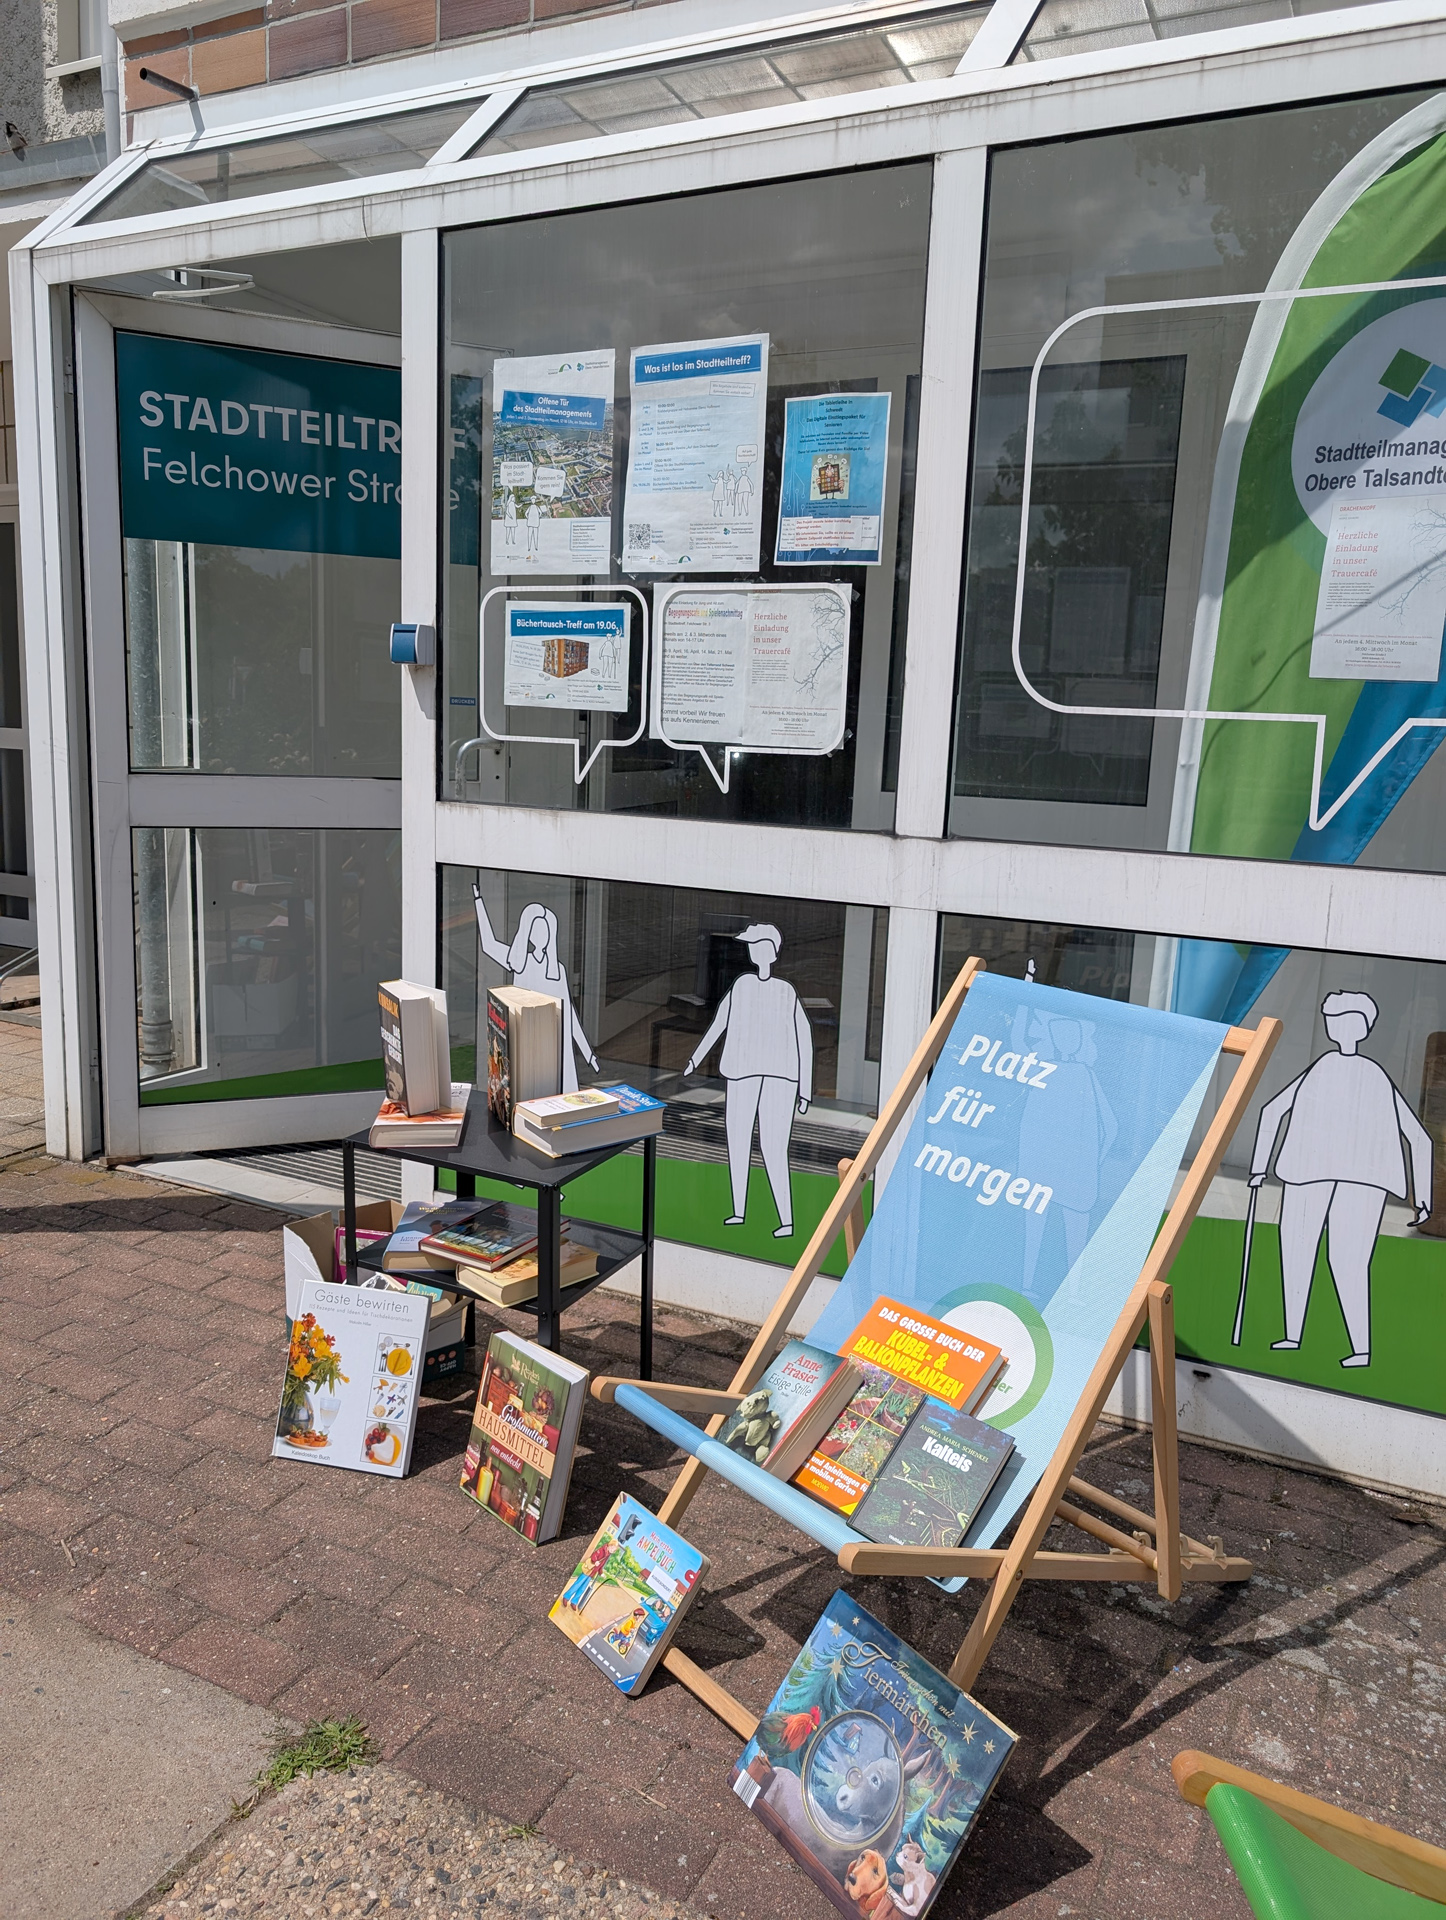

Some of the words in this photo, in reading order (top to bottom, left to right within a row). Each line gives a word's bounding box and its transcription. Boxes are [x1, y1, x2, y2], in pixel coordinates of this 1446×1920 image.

[644, 364, 661, 374] Was
[661, 363, 671, 373] ist
[671, 361, 684, 371] los
[684, 360, 695, 370] im
[696, 354, 751, 369] Stadtteiltreff?
[512, 404, 524, 413] des
[524, 405, 592, 418] Stadtteilmanagements
[537, 396, 559, 406] Offene
[559, 398, 570, 407] Tür
[139, 390, 466, 460] STADTTEILTRF
[143, 447, 336, 499] Felchower
[1304, 473, 1356, 492] Obere
[1337, 531, 1379, 540] Herzliche
[1335, 544, 1379, 553] Einladung
[1331, 568, 1378, 578] Trauercafé
[1332, 557, 1341, 565] in
[1343, 557, 1368, 565] unser
[516, 618, 582, 629] Büchertausch-Treff
[583, 621, 595, 630] am
[596, 620, 619, 630] 19.06.
[753, 624, 789, 634] Einladung
[753, 647, 791, 655] Trauercafé
[957, 1033, 1058, 1090] Platz
[926, 1085, 996, 1129] für
[913, 1142, 1054, 1215] morgen
[314, 1288, 351, 1306] Gäste
[356, 1294, 409, 1314] bewirten
[316, 1304, 335, 1312] Rezepte
[346, 1308, 361, 1316] Ideen
[370, 1312, 413, 1323] Tischdekorationen
[878, 1306, 901, 1324] DAS
[899, 1316, 938, 1340] GROSSE
[935, 1332, 965, 1353] BUCH
[962, 1345, 986, 1363] DER
[886, 1329, 931, 1361] KÜBEL-
[933, 1352, 950, 1371] &
[781, 1361, 819, 1384] Frasier
[793, 1353, 823, 1372] Anne
[852, 1335, 965, 1400] BALKONPFLANZEN
[767, 1373, 792, 1391] Eisige
[790, 1382, 812, 1397] Stille
[498, 1404, 549, 1449] Großmutters
[478, 1409, 545, 1469] HAUSMITTEL
[919, 1424, 942, 1439] ANDREA
[942, 1435, 961, 1449] MARIA
[961, 1445, 989, 1464] SCHENKEL
[291, 1449, 318, 1459] Kaleidoskop
[490, 1444, 500, 1455] neu
[500, 1448, 521, 1469] entdeckt
[921, 1435, 973, 1472] Kalteis
[809, 1465, 835, 1483] mobilen
[834, 1478, 857, 1496] Garten
[811, 1455, 826, 1467] und
[822, 1461, 860, 1488] Anleitungen
[860, 1482, 869, 1492] fü
[811, 1478, 830, 1492] MOEWIG
[636, 1535, 677, 1574] AMPELBUCH
[841, 1641, 948, 1750] Tiermärchen
[938, 1704, 956, 1719] mit
